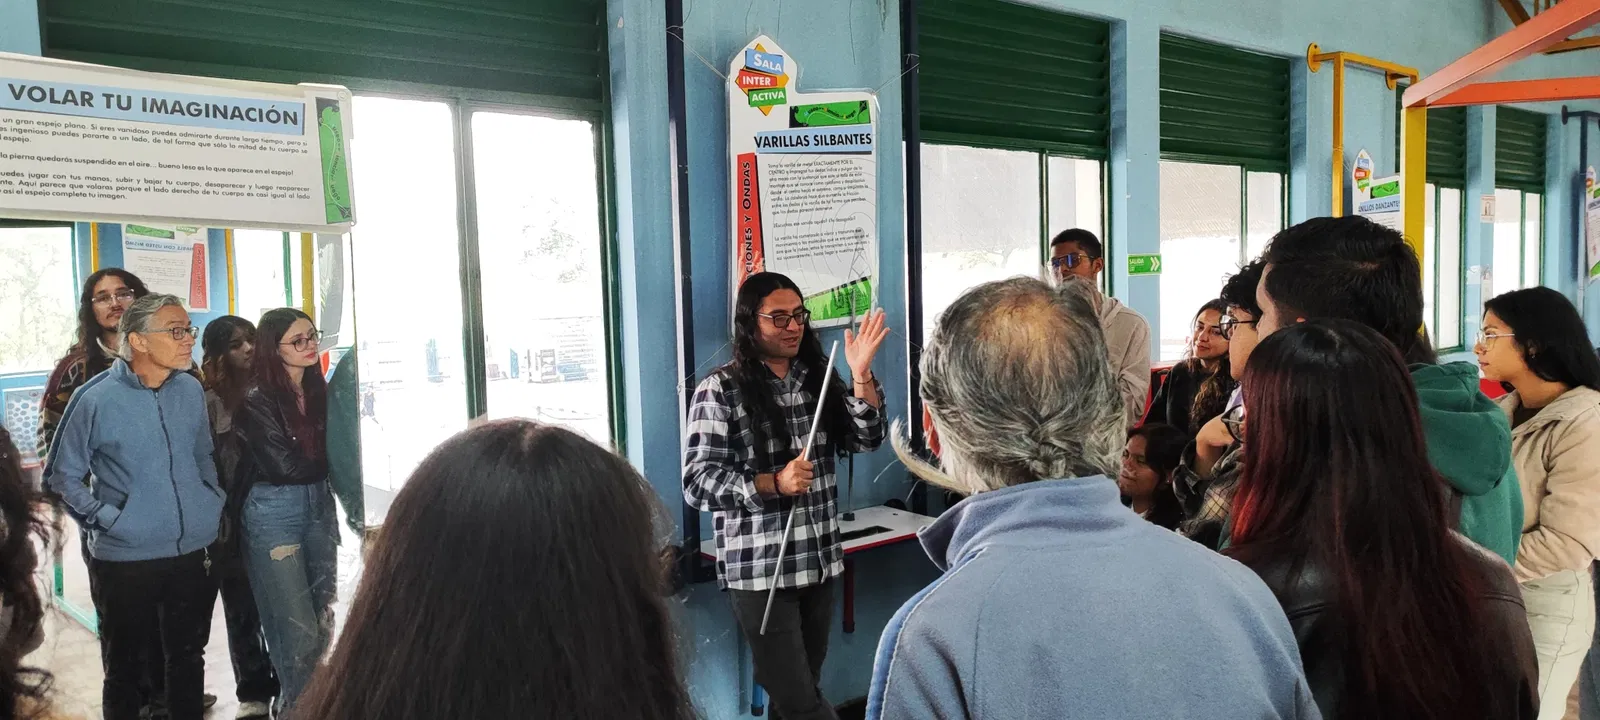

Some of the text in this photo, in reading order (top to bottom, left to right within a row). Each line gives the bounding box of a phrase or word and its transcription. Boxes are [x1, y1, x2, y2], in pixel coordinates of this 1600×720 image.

[754, 54, 782, 72] SALA
[743, 76, 770, 86] INTER
[752, 91, 784, 101] ACTIVA
[8, 83, 298, 125] VOLAR TU IMAGINACIÓN
[36, 120, 62, 128] espejo
[10, 126, 49, 134] ingenioso
[52, 130, 79, 138] puedes
[82, 132, 109, 140] pararte
[754, 133, 872, 148] VARILLAS SILBANTES
[36, 155, 72, 163] quedarás
[74, 157, 116, 165] suspendido
[28, 171, 48, 179] jugar
[205, 181, 245, 189] desaparecer
[25, 189, 50, 197] espejo
